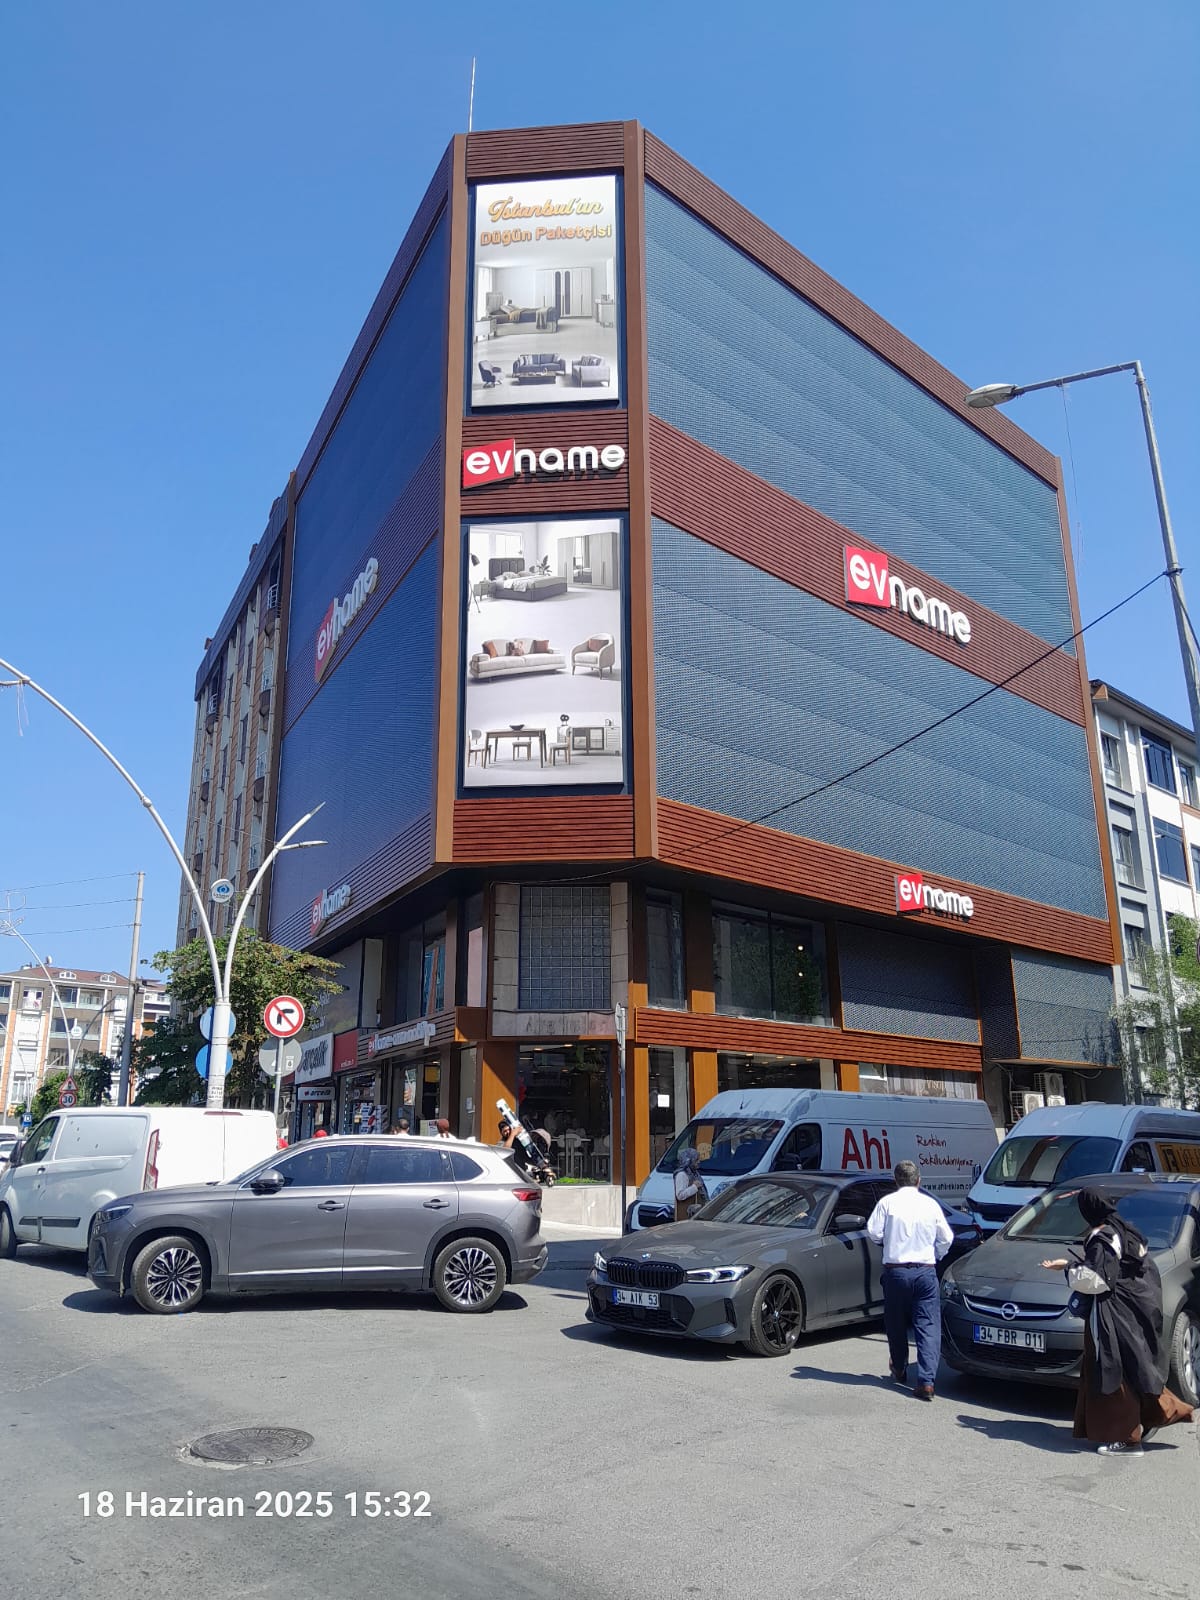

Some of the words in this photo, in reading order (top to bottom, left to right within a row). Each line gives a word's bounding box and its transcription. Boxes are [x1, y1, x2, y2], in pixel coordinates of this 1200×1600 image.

[488, 196, 603, 222] İstanbul'un
[480, 227, 532, 247] Düğün
[535, 224, 612, 242] Paketçisi
[465, 444, 626, 476] evname
[849, 554, 972, 644] evname
[899, 879, 975, 917] evname
[62, 1095, 73, 1104] 30
[841, 1128, 892, 1170] Ahi
[617, 1290, 626, 1302] 34
[648, 1294, 658, 1306] 53
[980, 1327, 993, 1341] 34
[997, 1329, 1017, 1344] FBR
[1025, 1333, 1042, 1347] 011
